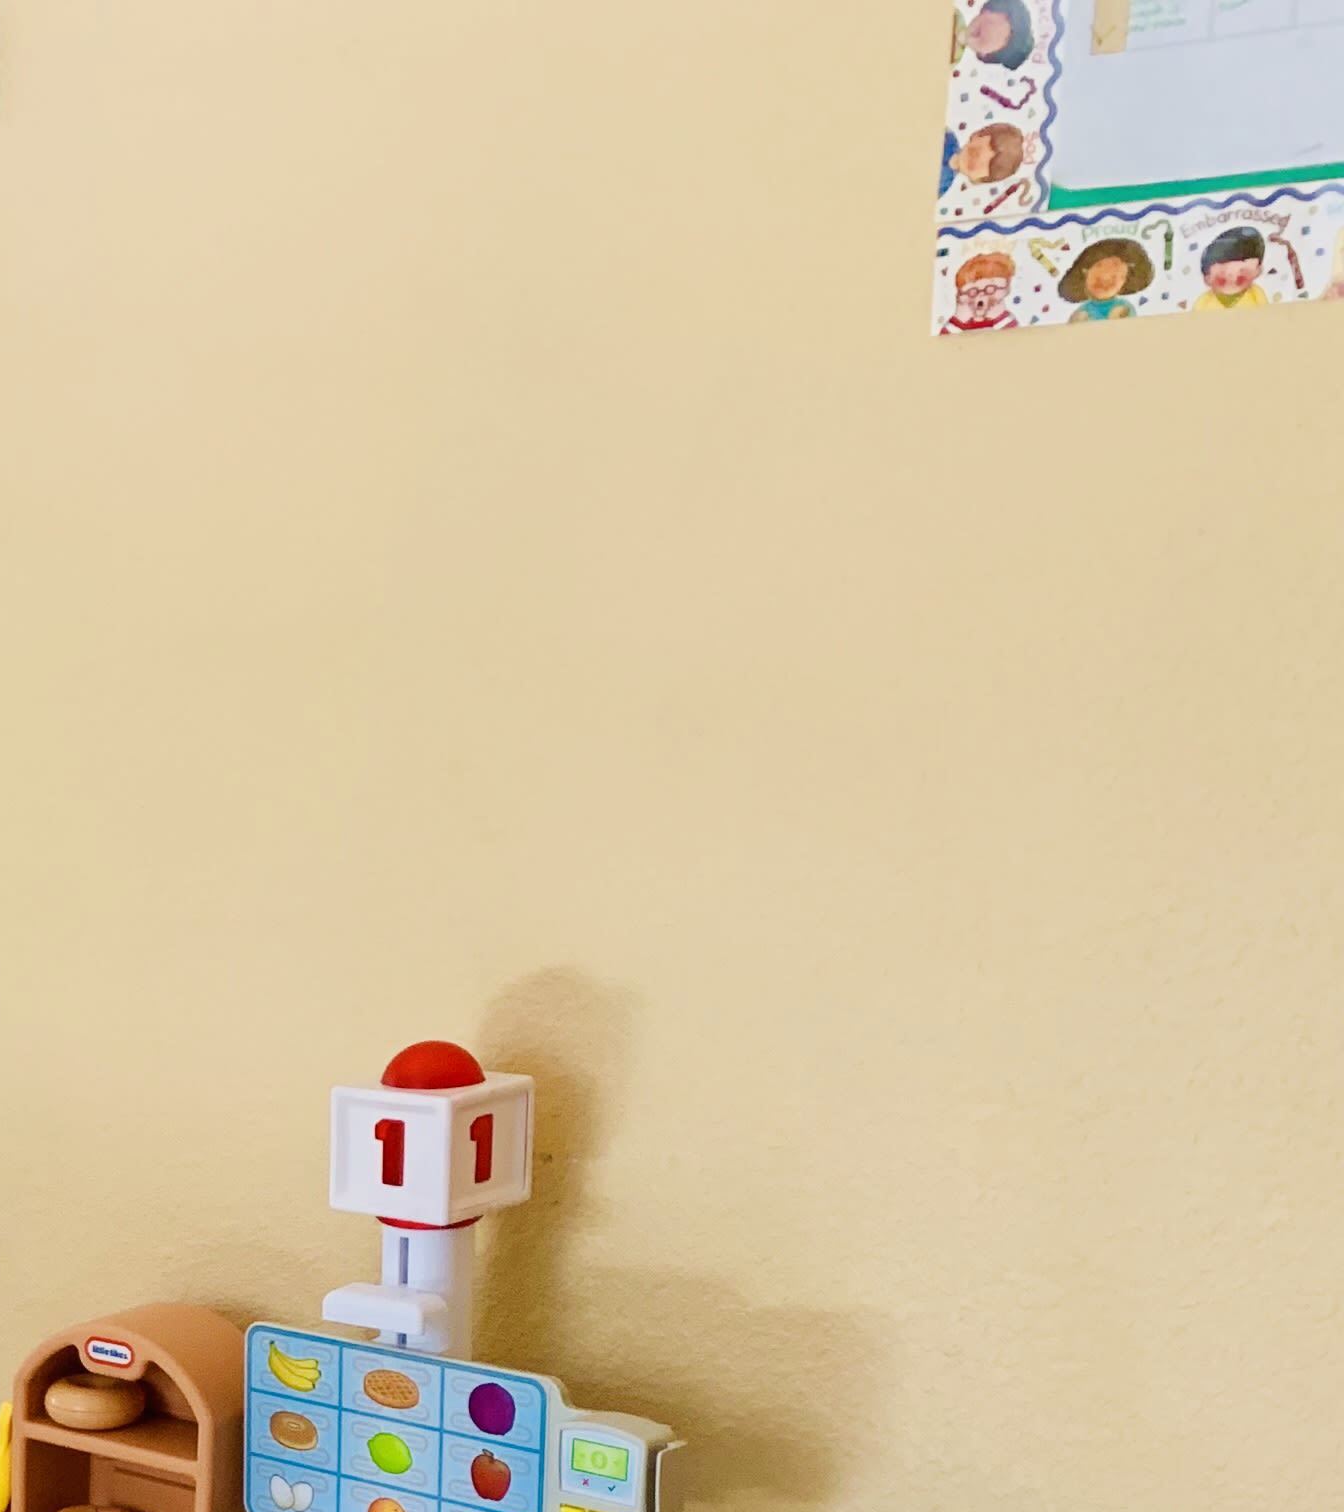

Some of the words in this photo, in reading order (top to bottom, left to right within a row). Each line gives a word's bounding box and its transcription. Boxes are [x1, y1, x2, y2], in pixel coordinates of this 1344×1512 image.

[1180, 208, 1292, 239] Embarrassed
[375, 1118, 405, 1187] 1
[470, 1113, 494, 1184] 1
